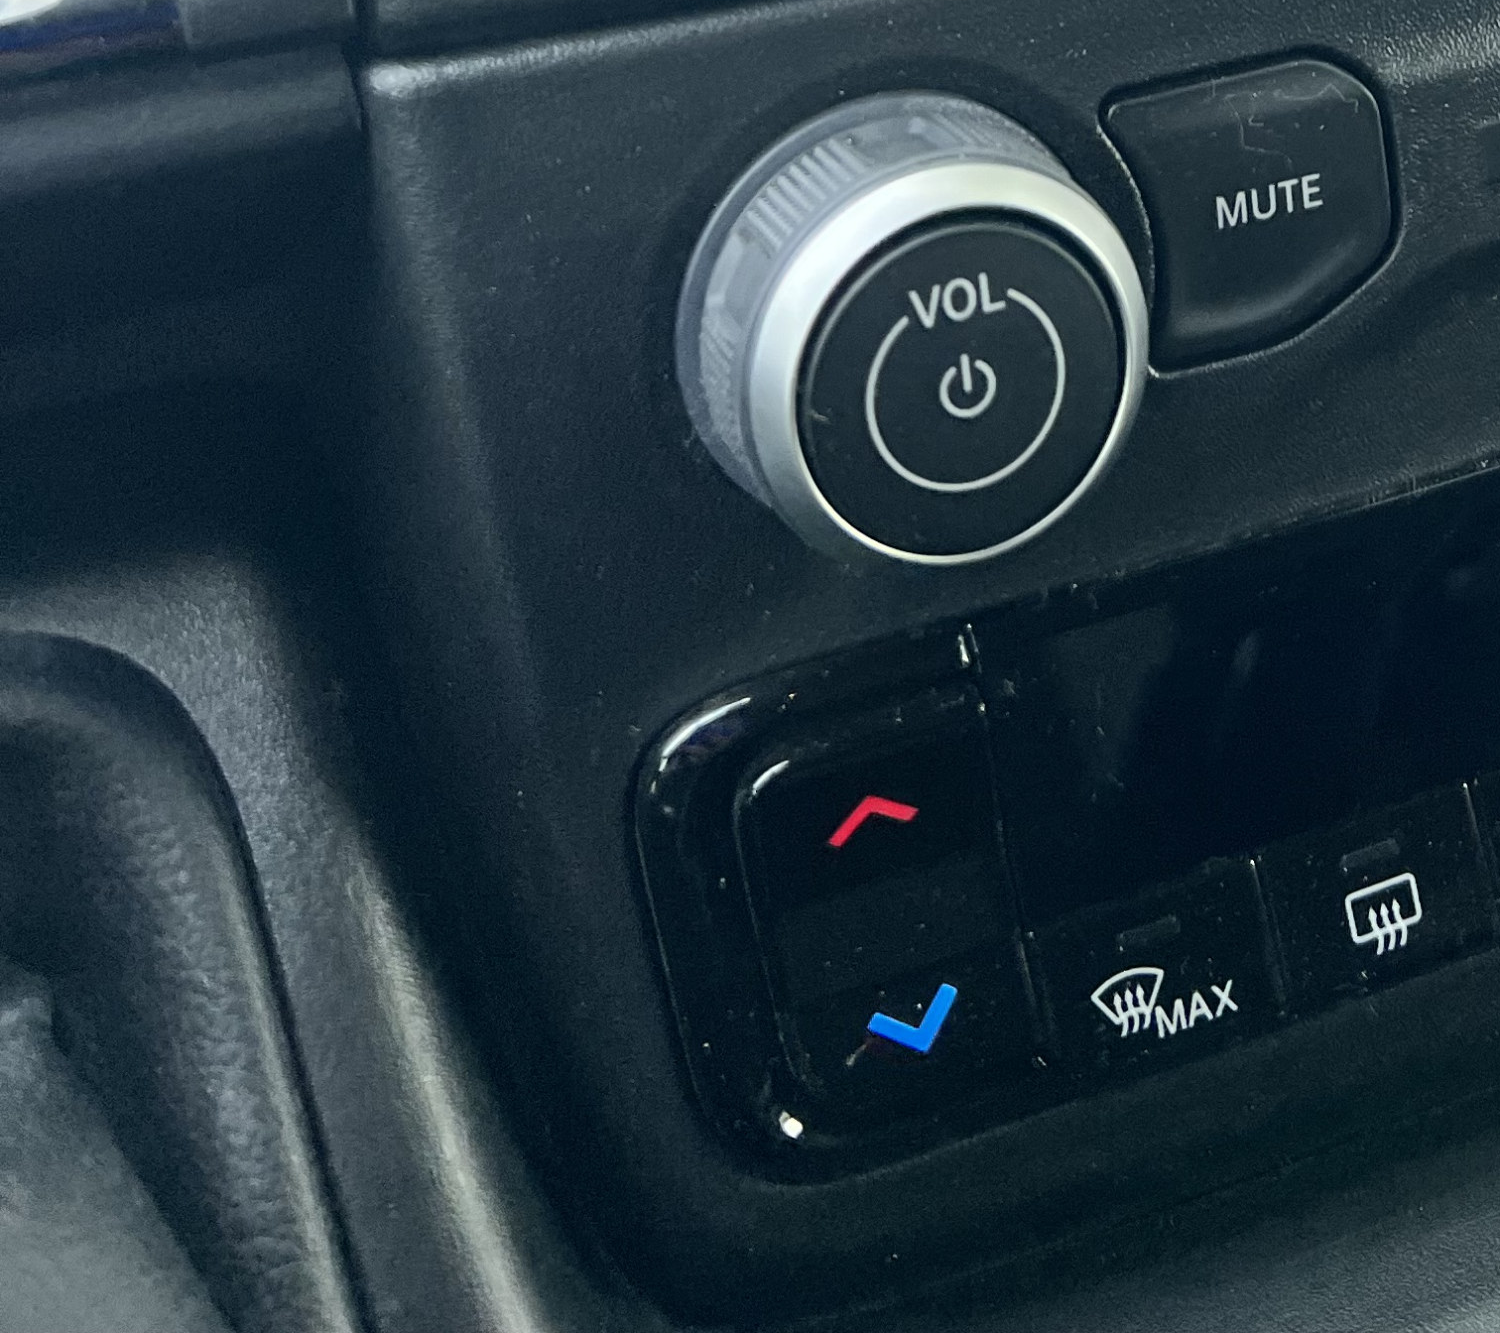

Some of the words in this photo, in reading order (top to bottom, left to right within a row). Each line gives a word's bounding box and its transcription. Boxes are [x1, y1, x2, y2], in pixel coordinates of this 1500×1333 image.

[1214, 172, 1323, 229] MUTE
[909, 272, 1007, 328] VOL
[1155, 978, 1239, 1039] MAX
